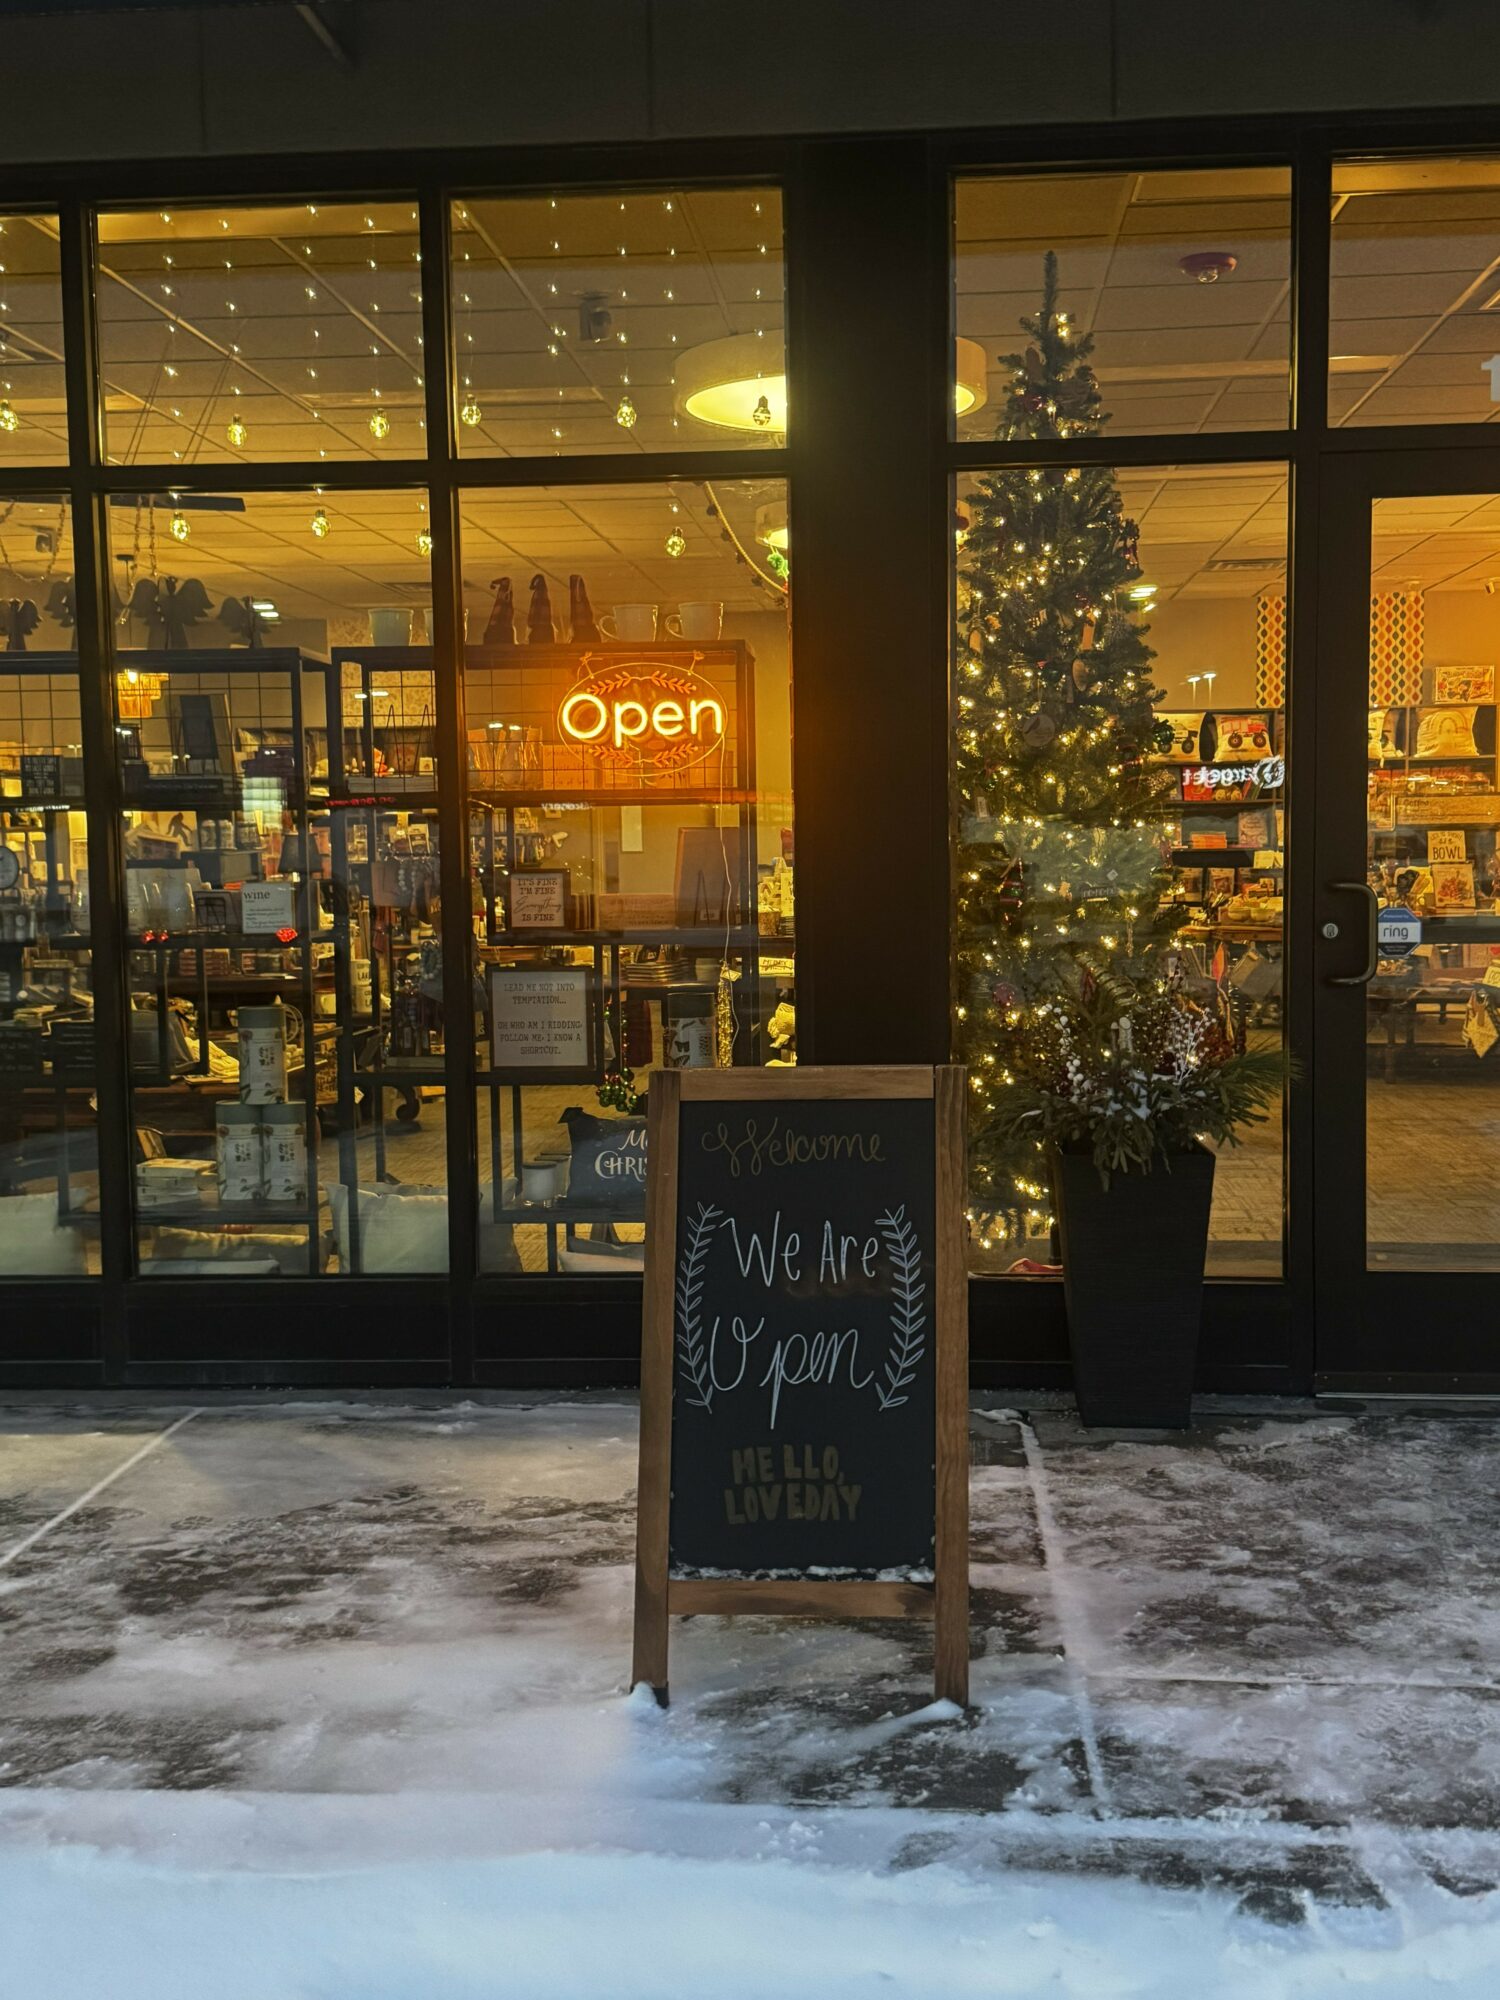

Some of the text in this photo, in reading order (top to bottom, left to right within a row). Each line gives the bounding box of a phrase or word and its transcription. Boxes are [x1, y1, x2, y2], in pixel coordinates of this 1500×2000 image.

[561, 692, 724, 749] Open
[1432, 846, 1463, 860] BOWL
[517, 878, 558, 886] IT'S FINE
[243, 890, 270, 900] wine
[520, 887, 556, 895] I'M FINE
[521, 913, 555, 921] IS FINE
[1383, 925, 1409, 940] ring
[504, 983, 575, 992] LEAD ME NOT INTO
[510, 1021, 526, 1030] WHO
[528, 1021, 538, 1030] AM
[541, 1021, 545, 1029] I
[500, 1034, 529, 1042] FOLLOW
[547, 1033, 551, 1042] I
[554, 1033, 573, 1041] KNOW
[576, 1033, 581, 1041] A
[618, 1129, 648, 1151] M
[702, 1117, 886, 1177] Welcome
[719, 1211, 879, 1287] We Are
[709, 1316, 875, 1430] Open
[724, 1484, 862, 1525] LOVEDAY
